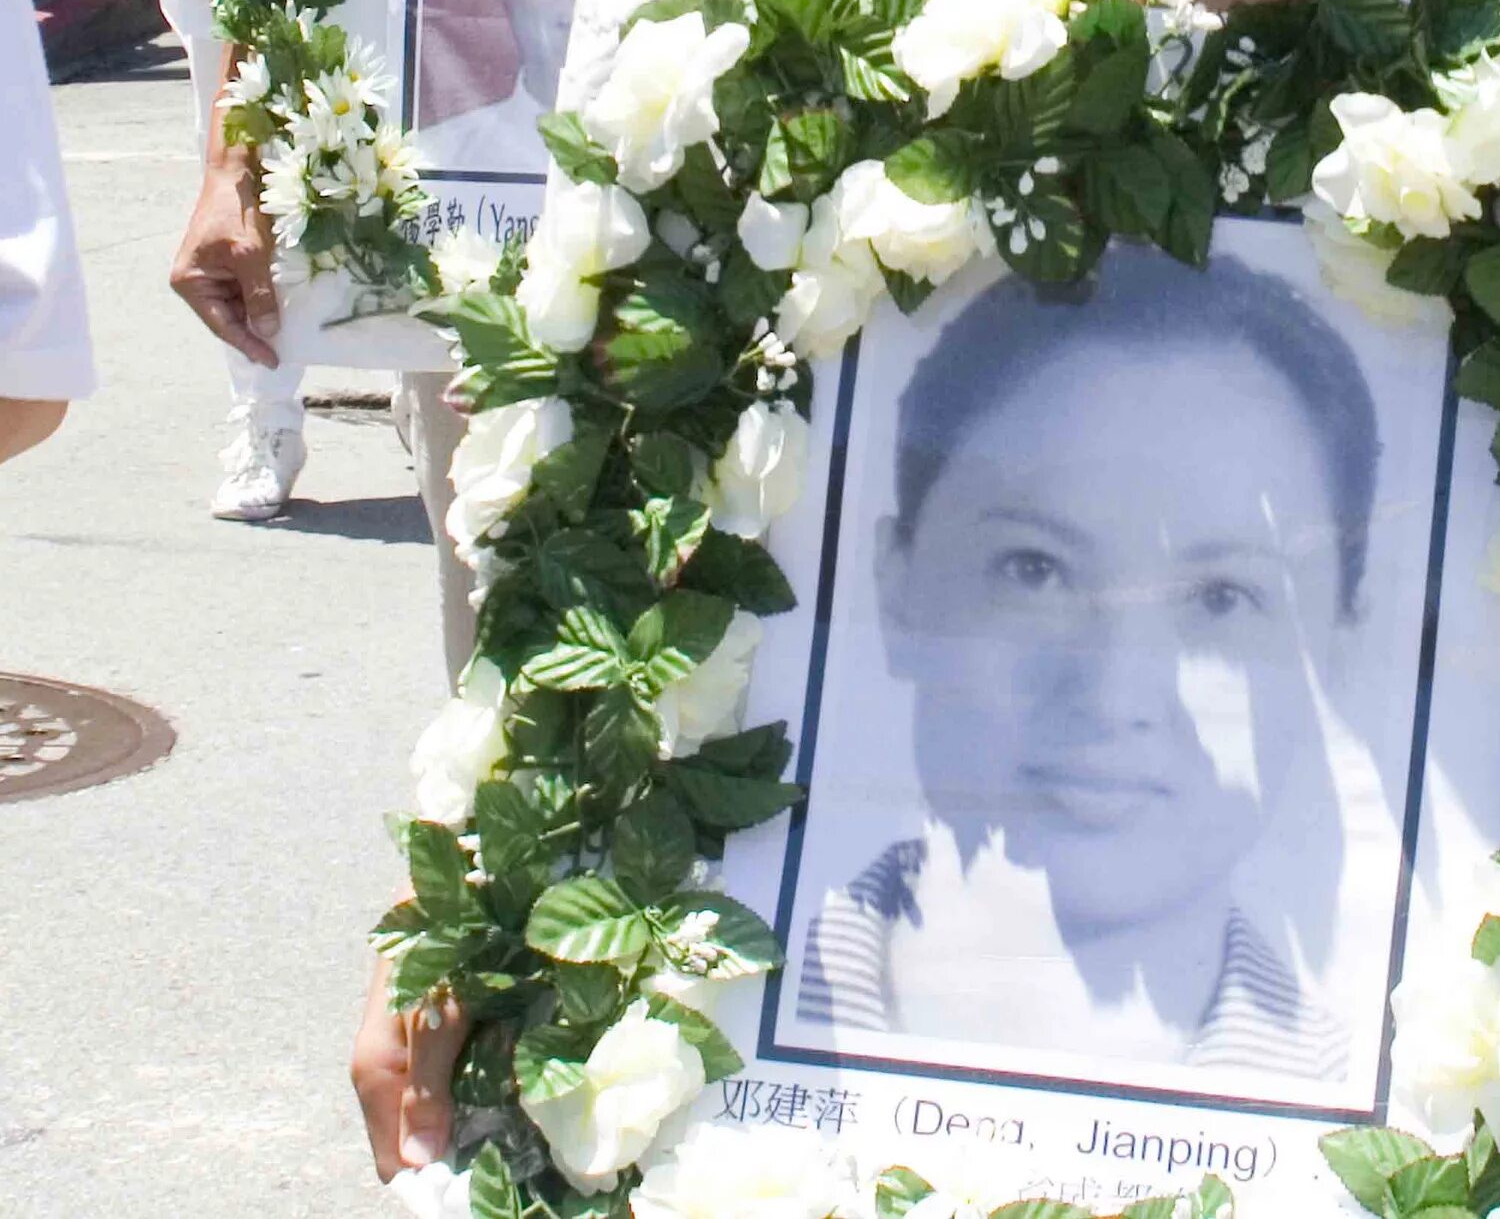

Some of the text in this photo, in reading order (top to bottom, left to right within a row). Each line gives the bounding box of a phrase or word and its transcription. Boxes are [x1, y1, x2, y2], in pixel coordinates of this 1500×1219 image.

[712, 1078, 863, 1135] 邓建萍
[1076, 1119, 1279, 1182] Jianping)
